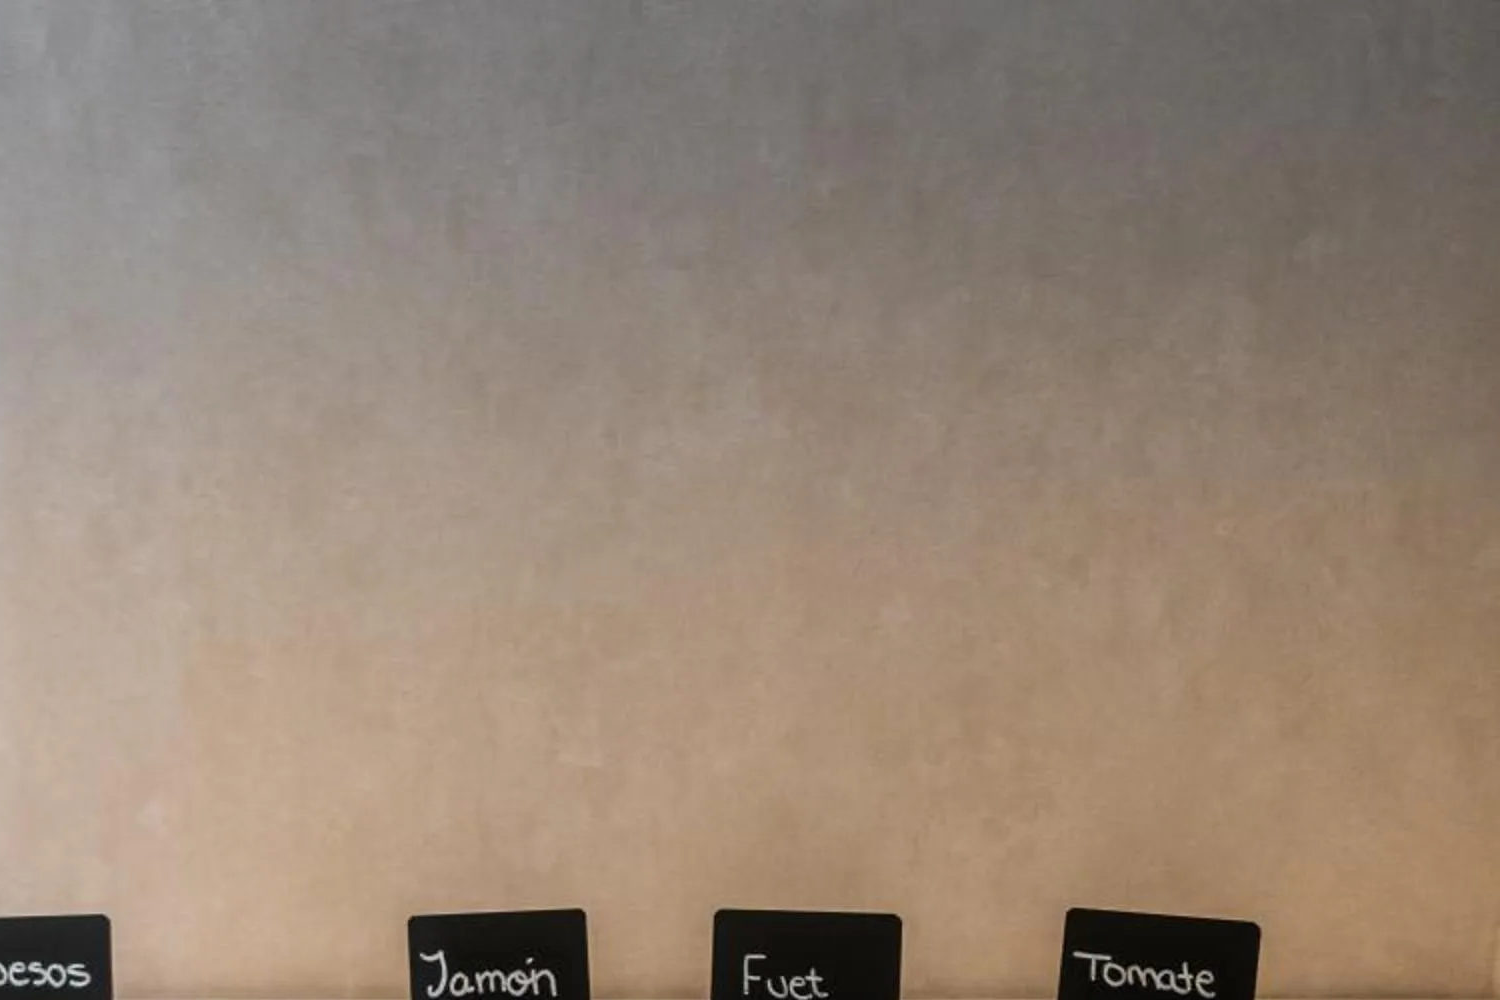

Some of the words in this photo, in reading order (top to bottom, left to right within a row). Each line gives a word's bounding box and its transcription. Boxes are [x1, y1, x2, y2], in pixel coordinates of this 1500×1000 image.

[419, 950, 557, 998] Jamón
[742, 954, 830, 1000] Fuet
[1073, 951, 1216, 998] Tomate
